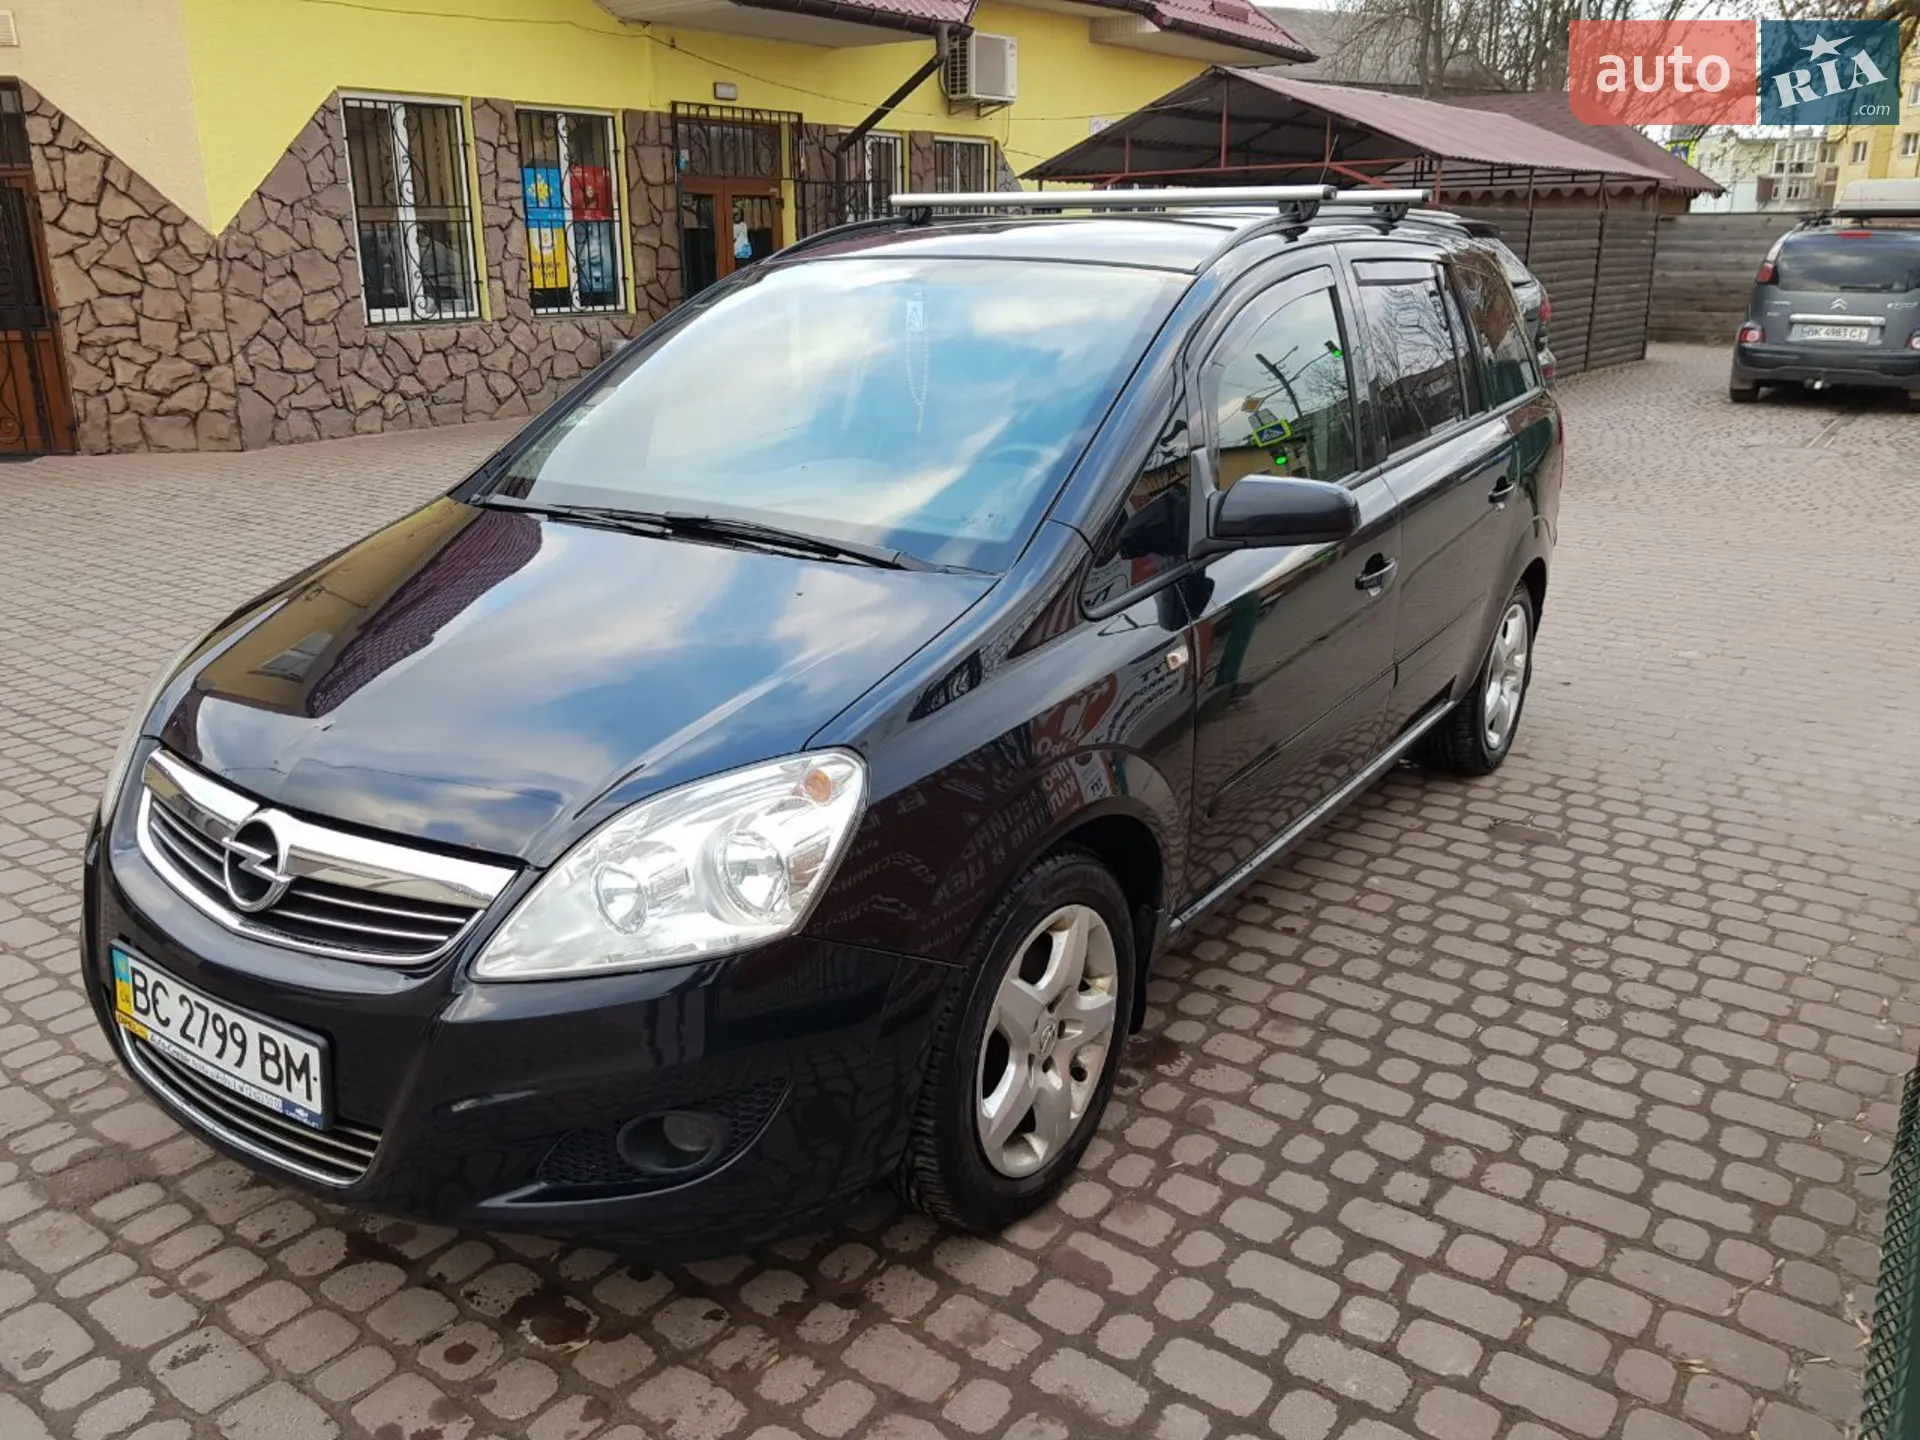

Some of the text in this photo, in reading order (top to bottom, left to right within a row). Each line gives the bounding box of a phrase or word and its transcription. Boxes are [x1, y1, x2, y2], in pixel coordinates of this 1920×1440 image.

[130, 966, 171, 1028] BC
[178, 994, 247, 1069] 2799
[258, 1031, 312, 1102] BM
